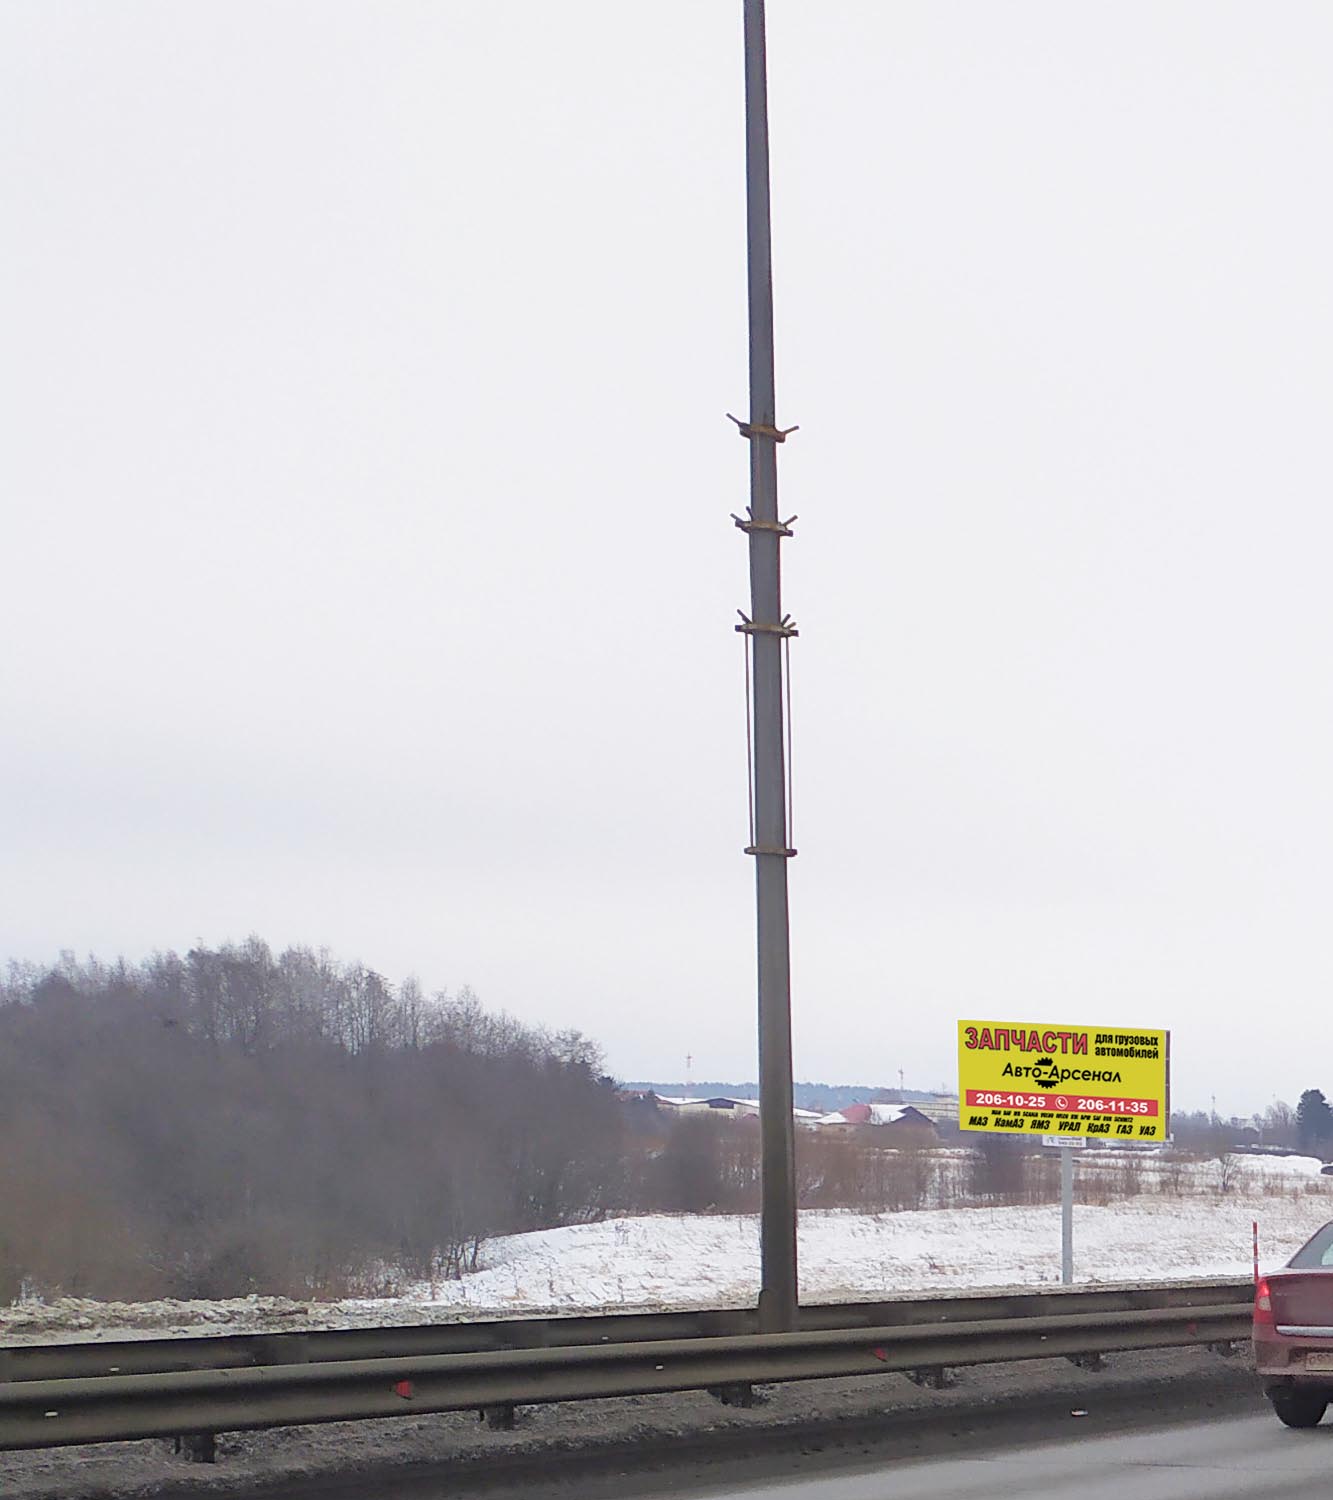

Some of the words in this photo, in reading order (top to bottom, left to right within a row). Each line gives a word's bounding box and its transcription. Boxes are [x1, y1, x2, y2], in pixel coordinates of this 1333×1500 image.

[965, 1027, 1088, 1055] ЗАПЧАСТИ
[1095, 1034, 1113, 1045] для
[1115, 1035, 1158, 1046] грузовых
[1095, 1047, 1159, 1059] автомобилей
[1002, 1062, 1122, 1083] Авто-Арсенал
[976, 1093, 1046, 1108] 206-10-25
[1077, 1099, 1148, 1113] 206-11-35
[969, 1116, 988, 1127] МАЗ
[994, 1117, 1024, 1129] КамАЗ
[1030, 1119, 1051, 1130] ЯМЗ
[1058, 1121, 1081, 1132] УРАЛ
[1087, 1122, 1111, 1133] КрАЗ
[1116, 1124, 1133, 1135] ГАЗ
[1139, 1125, 1156, 1136] УАЗ
